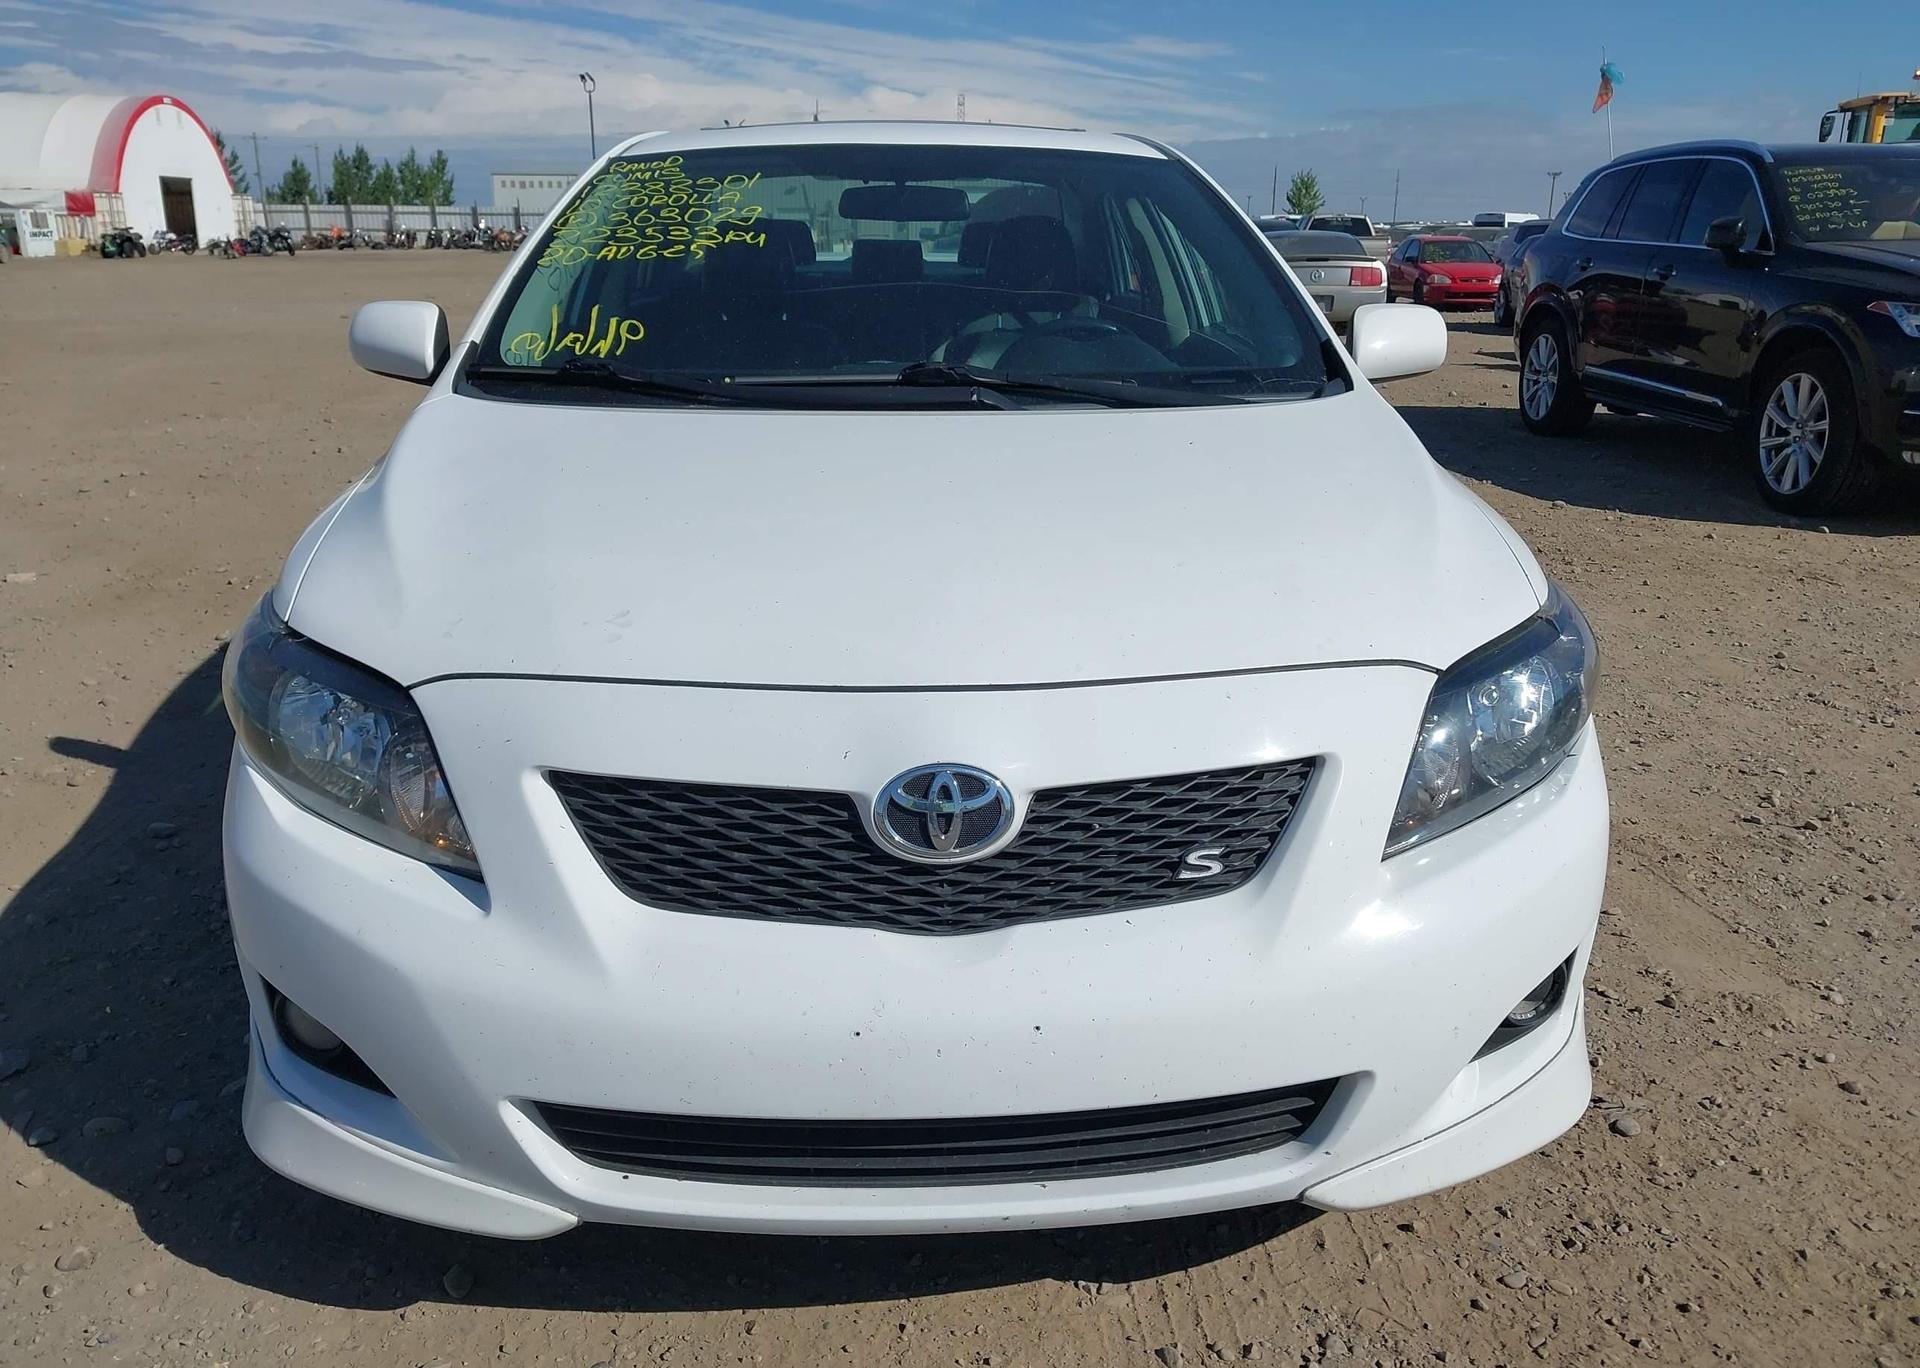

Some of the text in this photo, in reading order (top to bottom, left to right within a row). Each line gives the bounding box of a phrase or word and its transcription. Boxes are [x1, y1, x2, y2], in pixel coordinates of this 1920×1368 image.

[612, 191, 742, 209] COROLLA
[29, 230, 54, 239] IMPACT
[1175, 846, 1225, 880] S
